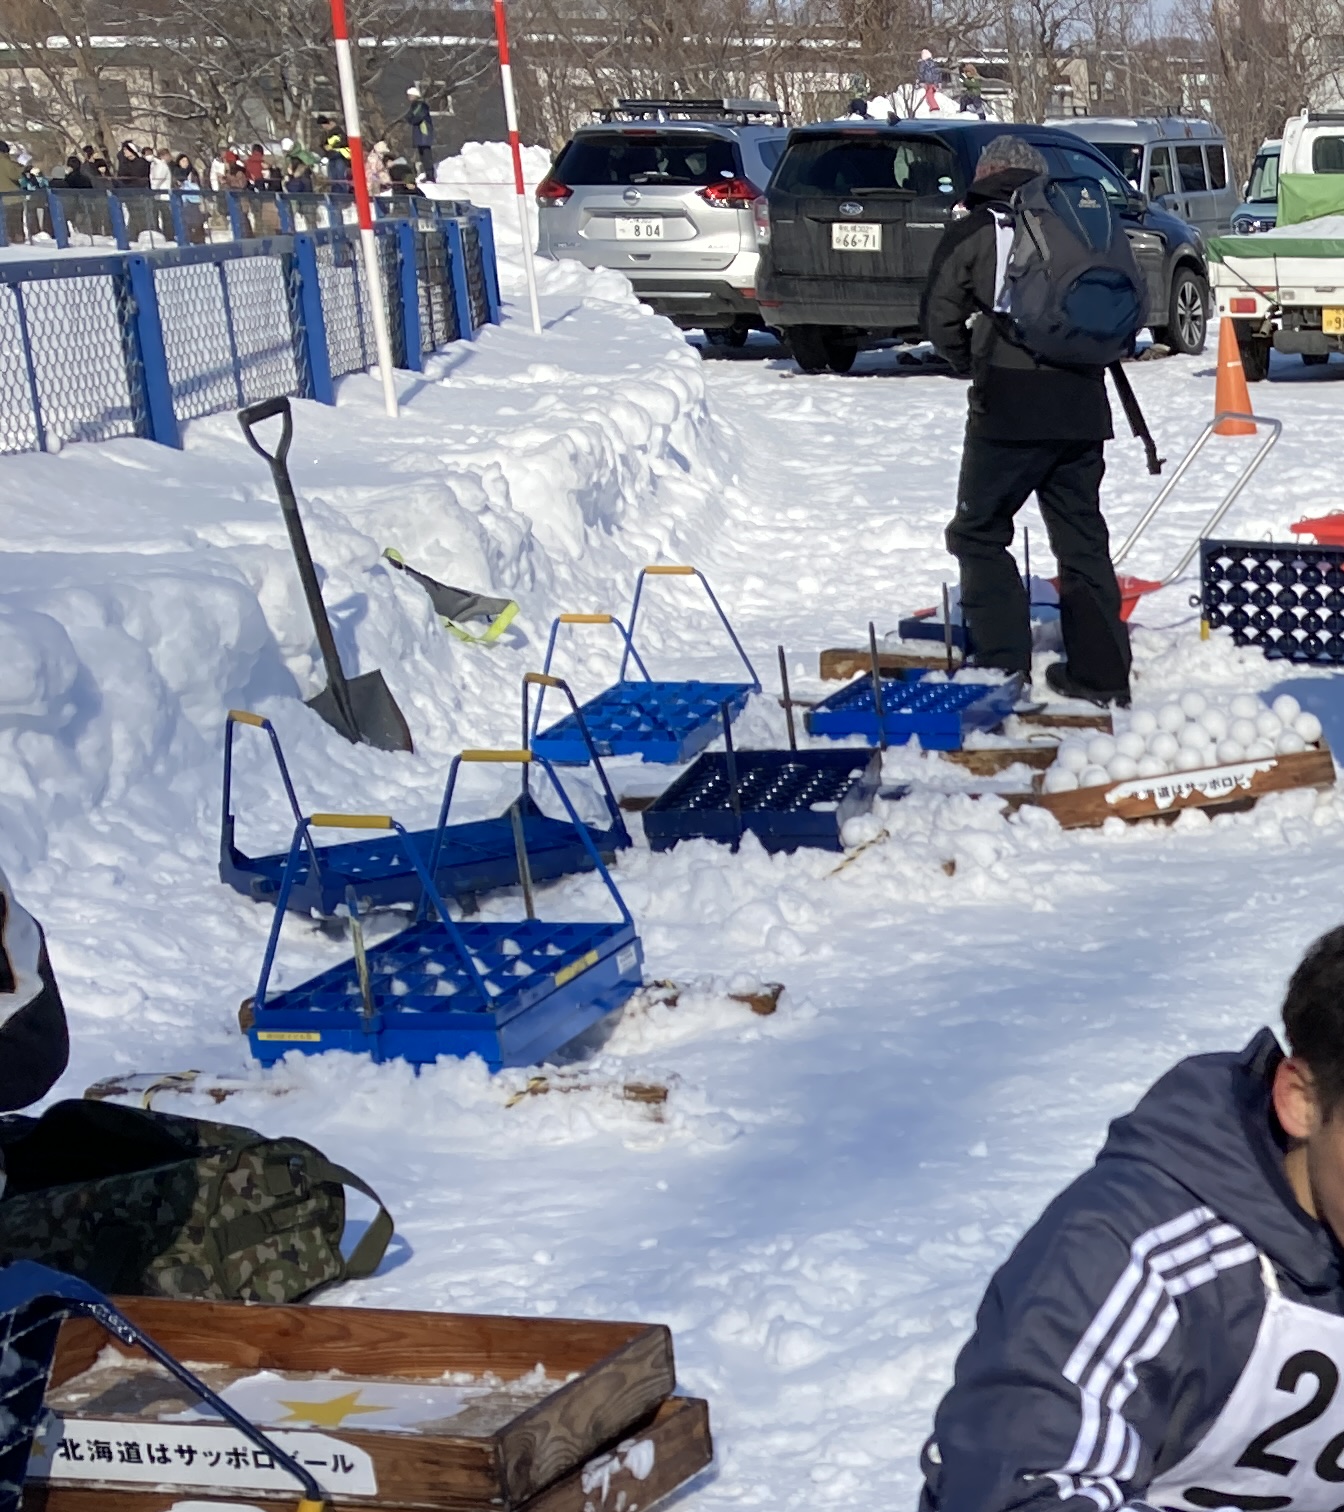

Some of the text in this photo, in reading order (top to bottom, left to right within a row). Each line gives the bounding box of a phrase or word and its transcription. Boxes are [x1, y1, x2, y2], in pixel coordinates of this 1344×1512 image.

[843, 233, 876, 248] 66-71
[57, 1437, 355, 1473] 北海道はサッポロール
